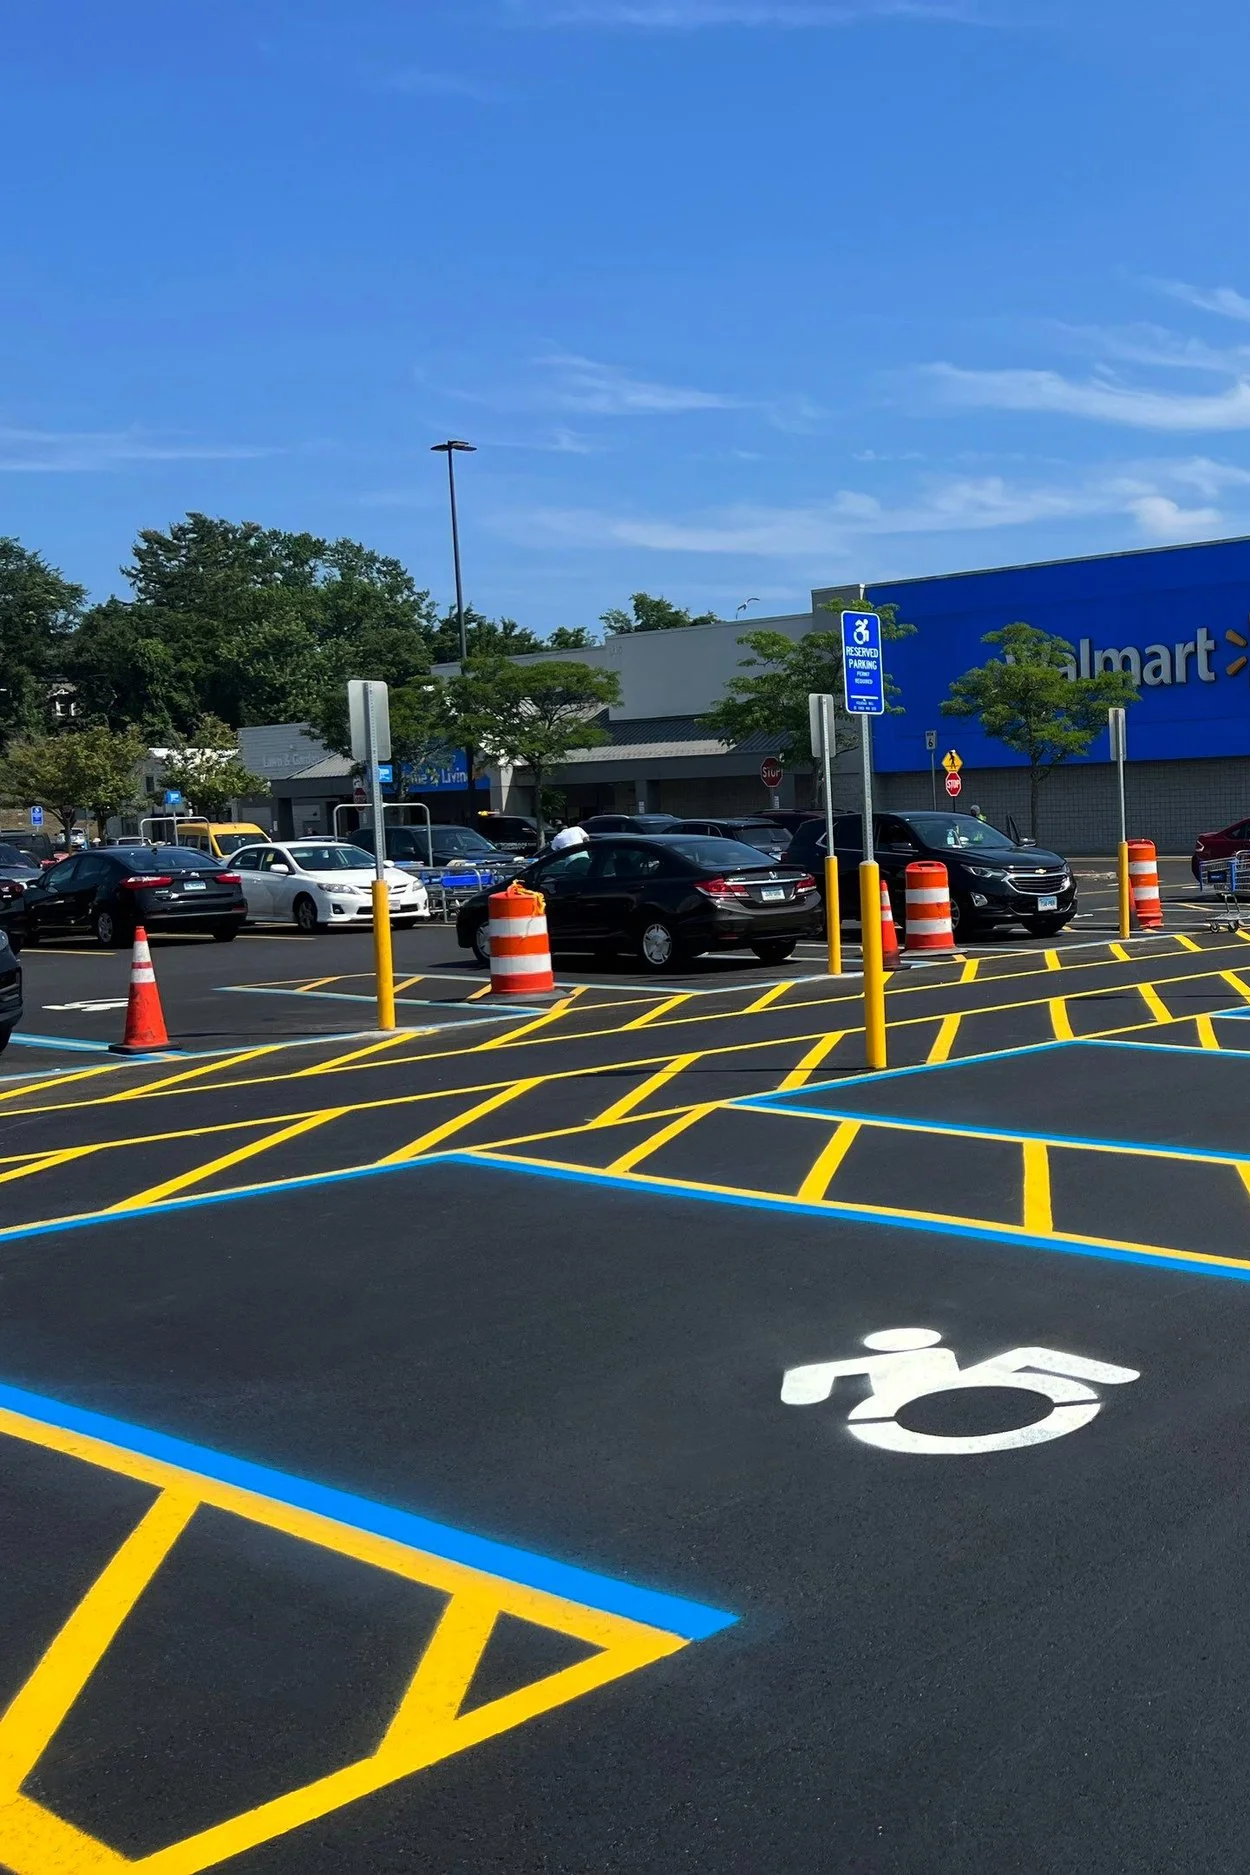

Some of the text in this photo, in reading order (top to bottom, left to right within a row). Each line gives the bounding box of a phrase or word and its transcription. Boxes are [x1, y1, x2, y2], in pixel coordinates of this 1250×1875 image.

[846, 646, 879, 658] RESERVED
[848, 659, 877, 670] PARKING
[928, 738, 934, 748] 6
[441, 768, 468, 784] Livin
